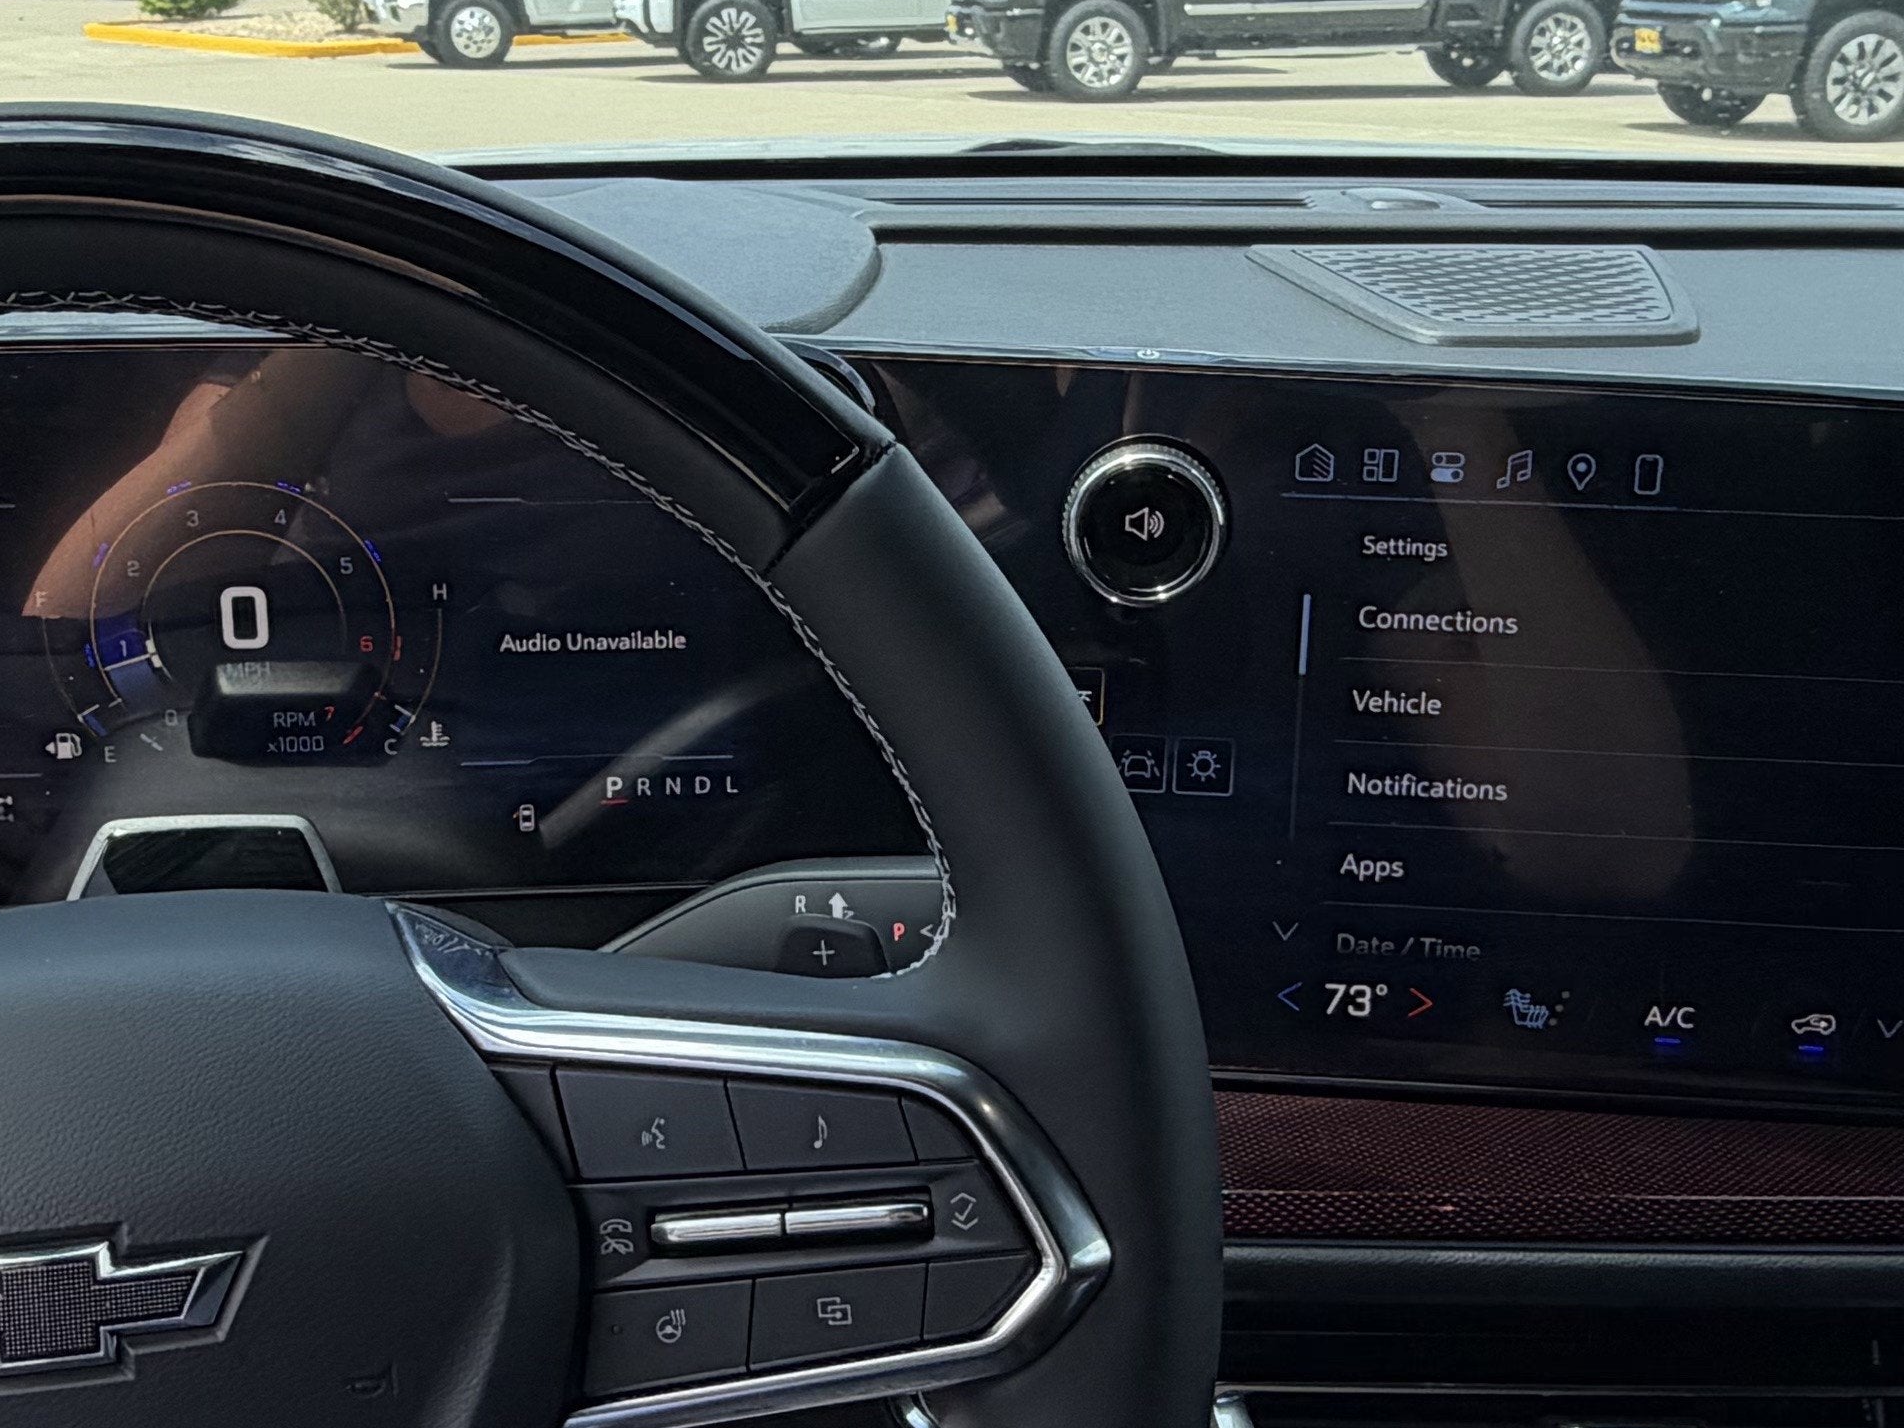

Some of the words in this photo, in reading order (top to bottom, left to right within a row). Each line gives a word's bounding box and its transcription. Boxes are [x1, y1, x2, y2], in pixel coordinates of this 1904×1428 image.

[186, 510, 199, 528] 3
[274, 509, 287, 526] 4
[1362, 535, 1448, 562] Settings
[127, 560, 140, 577] 2
[339, 557, 353, 575] 5
[34, 591, 48, 608] F
[432, 583, 448, 601] H
[220, 586, 270, 650] 0
[1358, 605, 1519, 635] Connections
[360, 635, 374, 652] 6
[499, 632, 562, 653] Audio
[566, 630, 687, 651] Unavailable
[1352, 689, 1442, 715] Vehicle
[272, 711, 316, 728] RPM
[323, 706, 336, 721] 7
[104, 745, 117, 762] E
[266, 735, 325, 753] x1000
[384, 738, 398, 756] C
[606, 776, 623, 797] P
[637, 777, 652, 796] R
[665, 776, 681, 796] N
[695, 775, 711, 795] D
[726, 775, 739, 794] L
[1347, 772, 1508, 801] Notifications
[1339, 853, 1405, 882] Apps
[795, 895, 807, 914] R
[892, 922, 906, 942] P
[1336, 932, 1395, 955] Date
[1419, 937, 1481, 960] Time
[1324, 983, 1388, 1017] 73°
[1644, 1005, 1696, 1029] A/C
